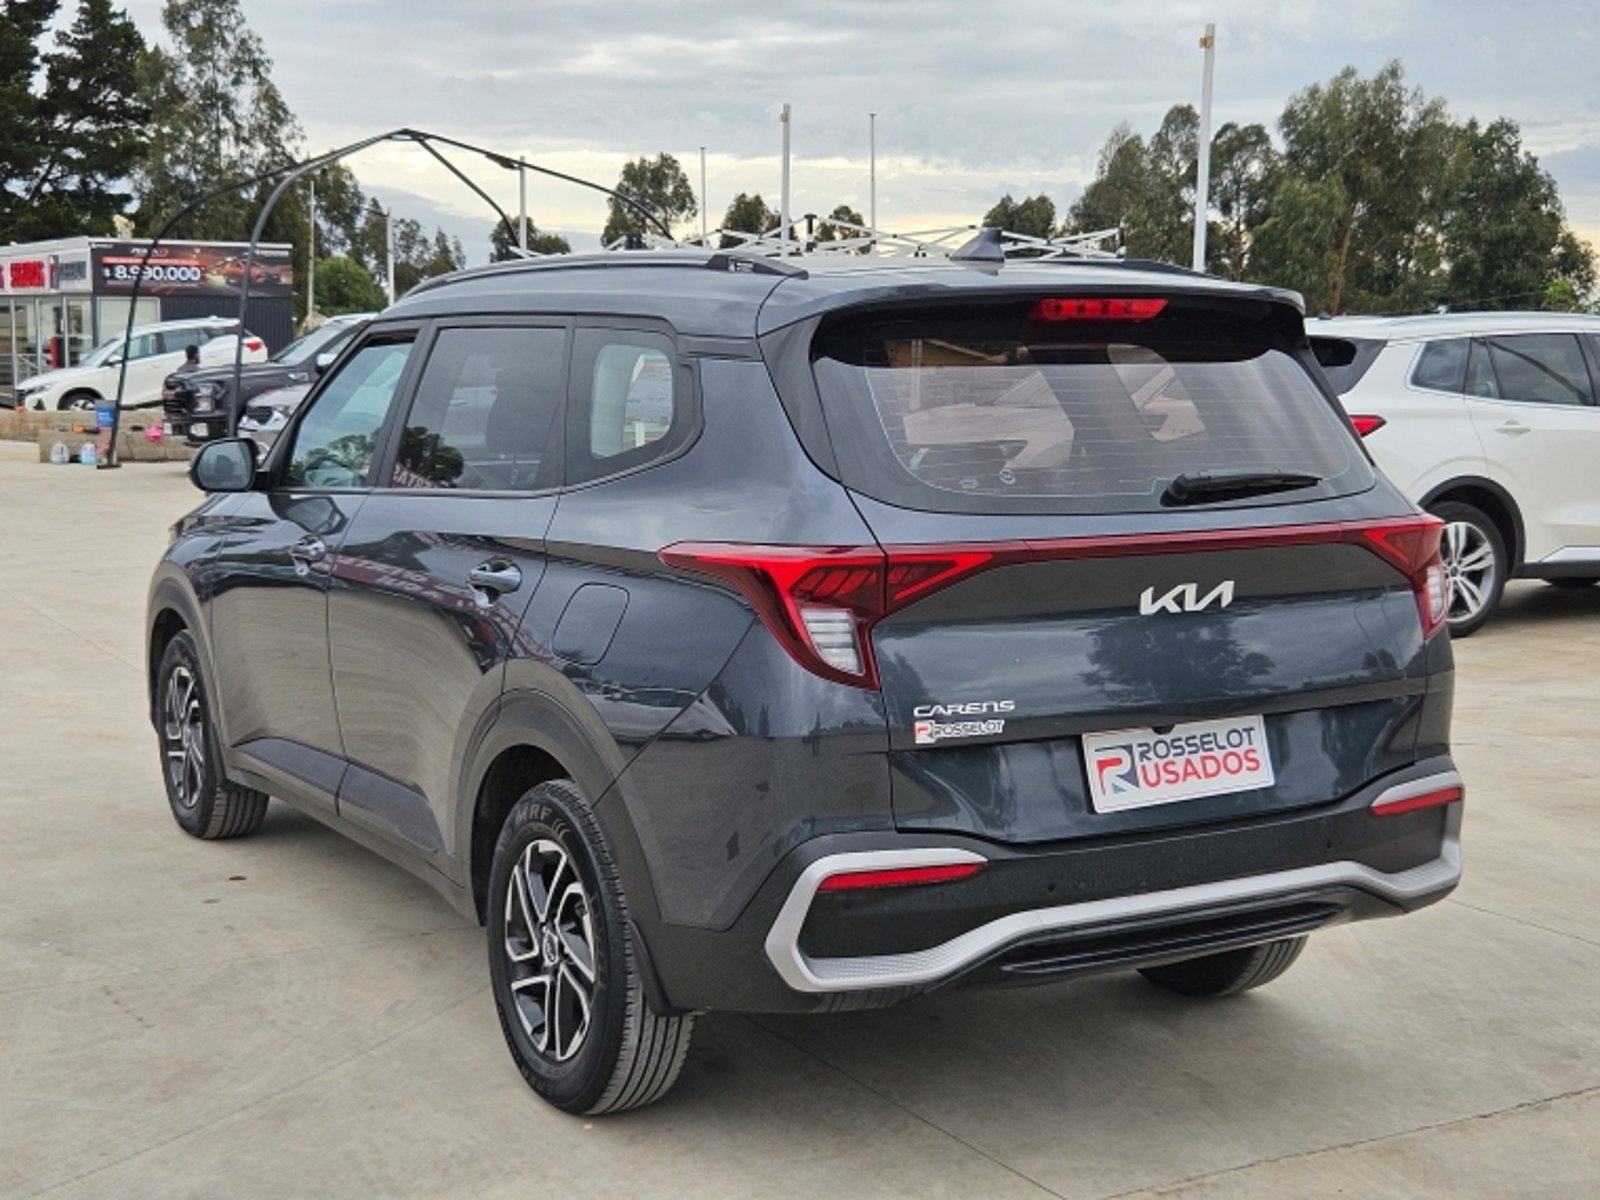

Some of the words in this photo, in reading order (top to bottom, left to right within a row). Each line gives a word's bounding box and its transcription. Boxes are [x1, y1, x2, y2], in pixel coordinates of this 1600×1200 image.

[1139, 580, 1235, 616] KIA
[913, 700, 1015, 717] CARENS
[934, 719, 1005, 739] ROSSELOT
[1136, 727, 1255, 763] ROSSELOT
[1140, 748, 1261, 788] USADOS
[515, 803, 553, 826] MRF
